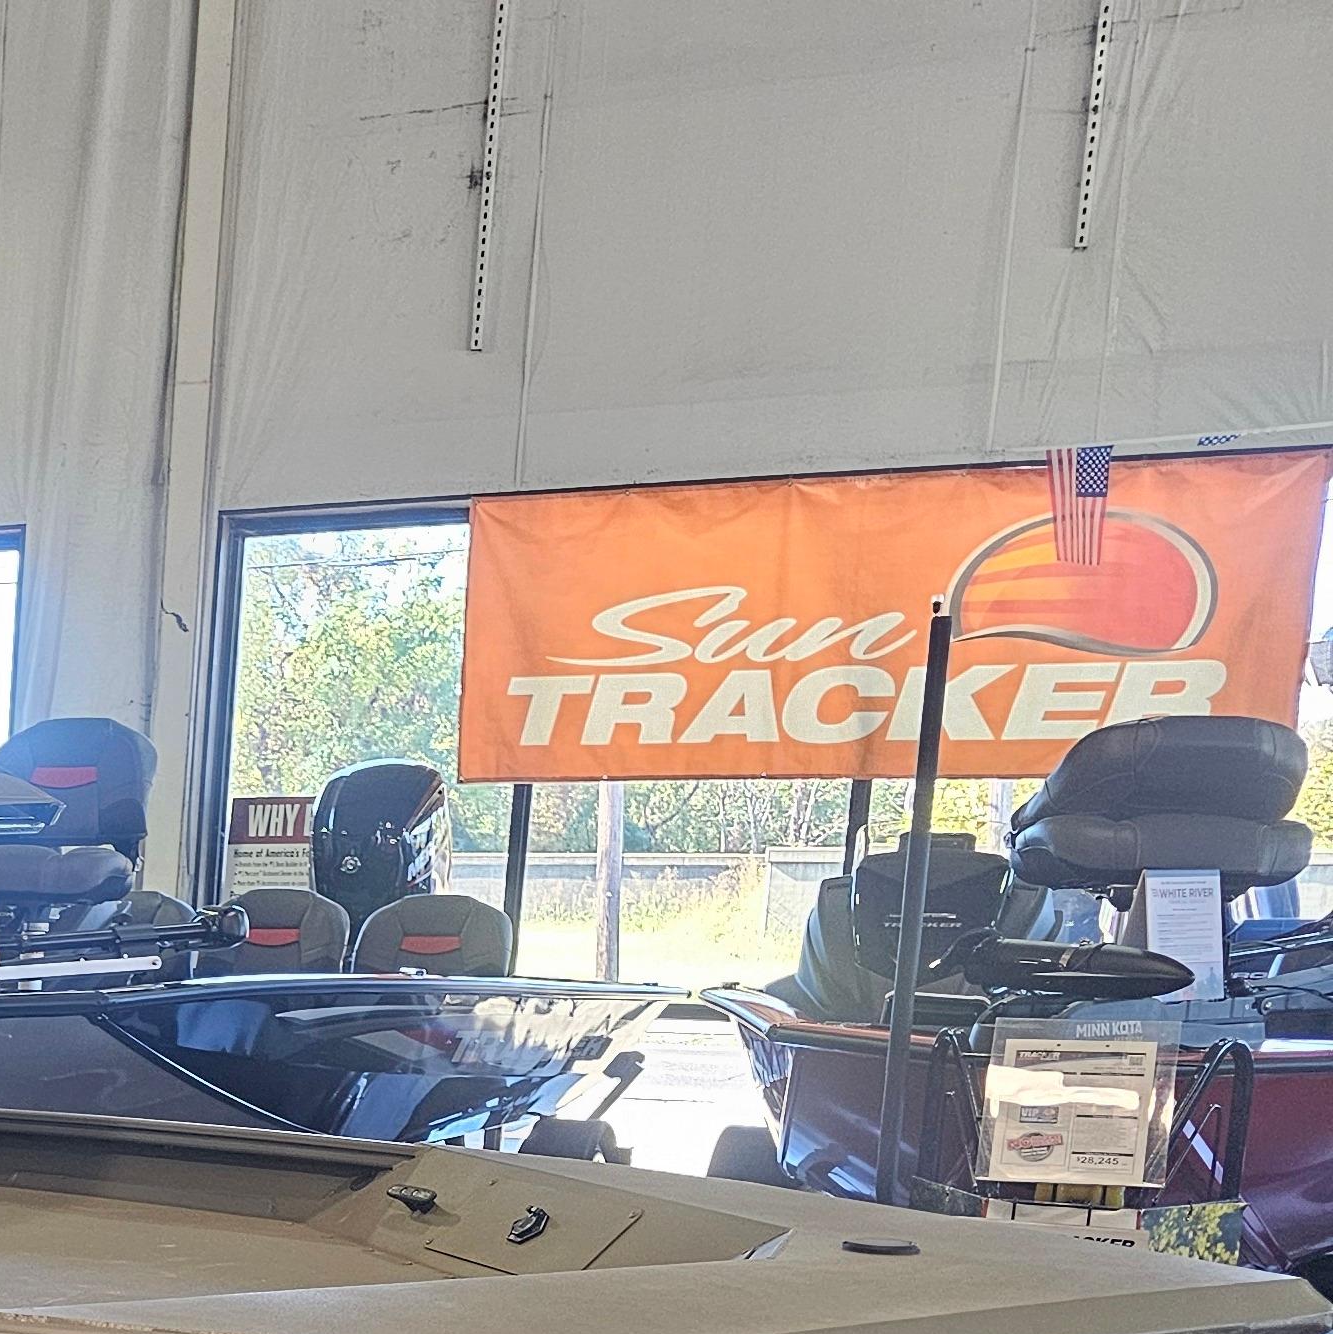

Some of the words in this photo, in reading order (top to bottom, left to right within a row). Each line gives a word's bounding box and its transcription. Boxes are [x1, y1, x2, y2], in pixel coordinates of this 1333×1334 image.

[545, 585, 917, 665] Sun
[506, 660, 1227, 745] TRACKER
[248, 804, 300, 837] WHY
[1160, 888, 1187, 898] WHITE
[1189, 888, 1213, 897] RIVER
[1076, 1023, 1110, 1038] MINN
[1112, 1021, 1143, 1035] KOTA
[1077, 1157, 1119, 1165] $28,245
